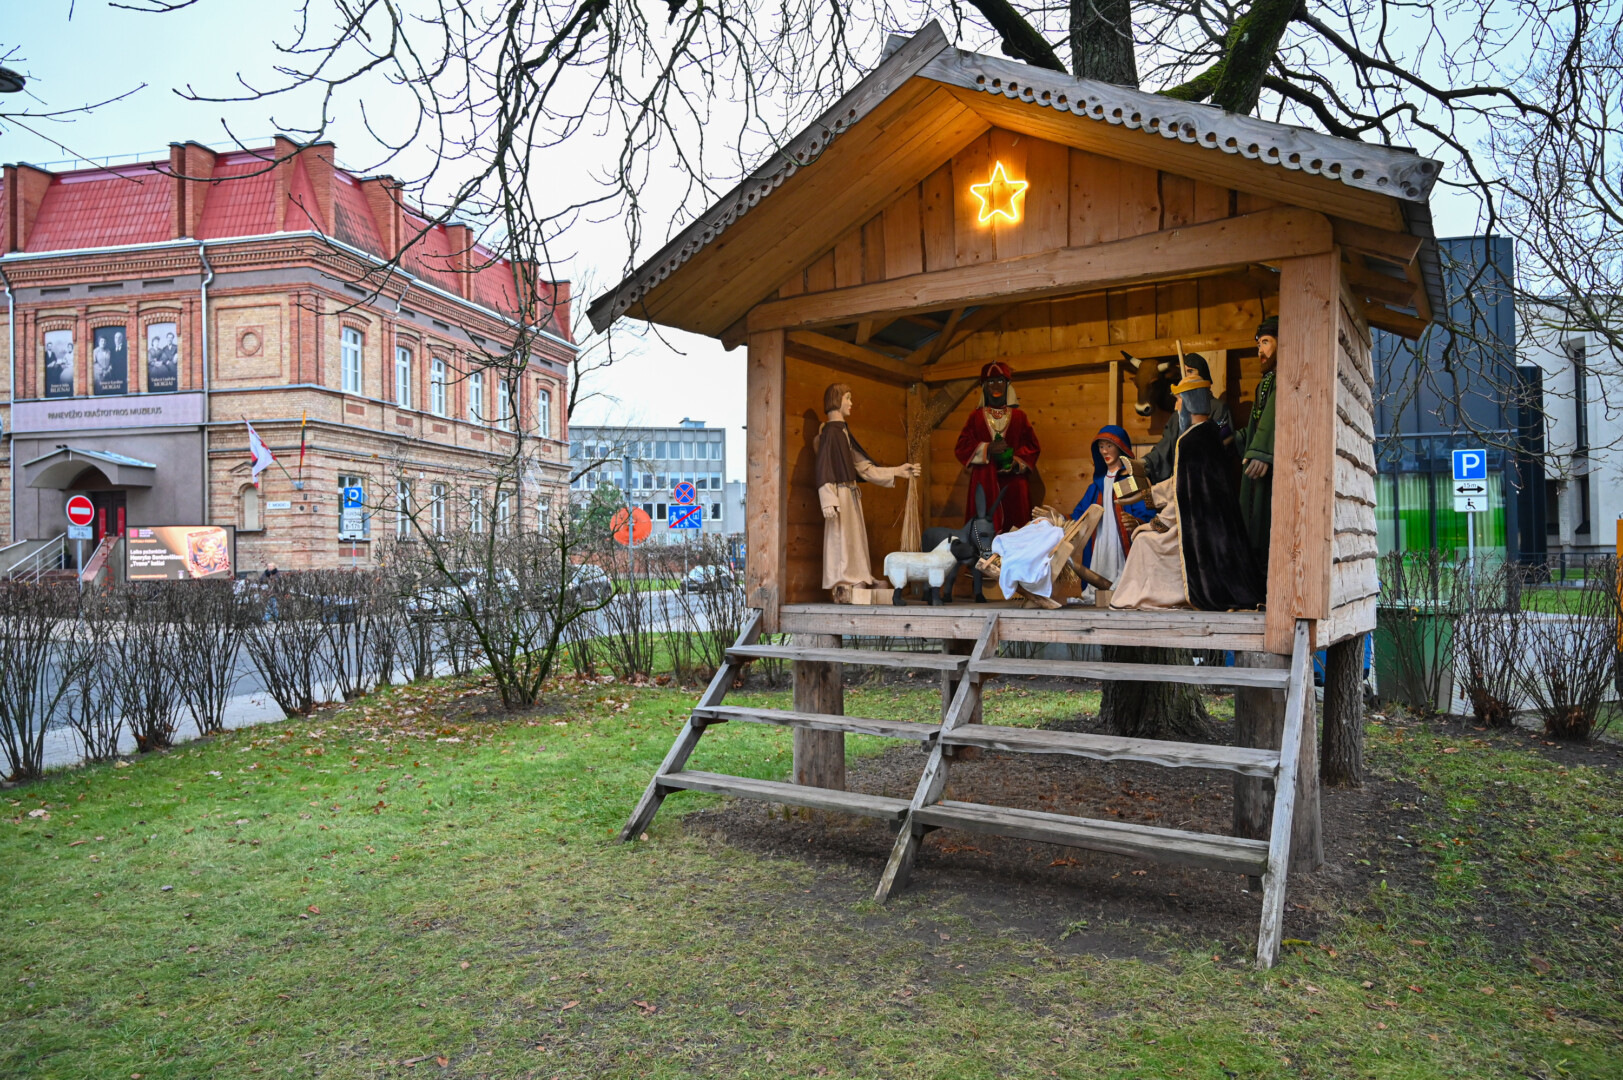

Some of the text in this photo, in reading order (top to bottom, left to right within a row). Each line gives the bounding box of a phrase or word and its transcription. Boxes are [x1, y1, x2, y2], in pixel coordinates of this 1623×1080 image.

[48, 407, 162, 419] PANEVĖŽIO KRAŠTOTYROS MUZIEJUS
[1462, 453, 1480, 477] P
[349, 489, 360, 506] P
